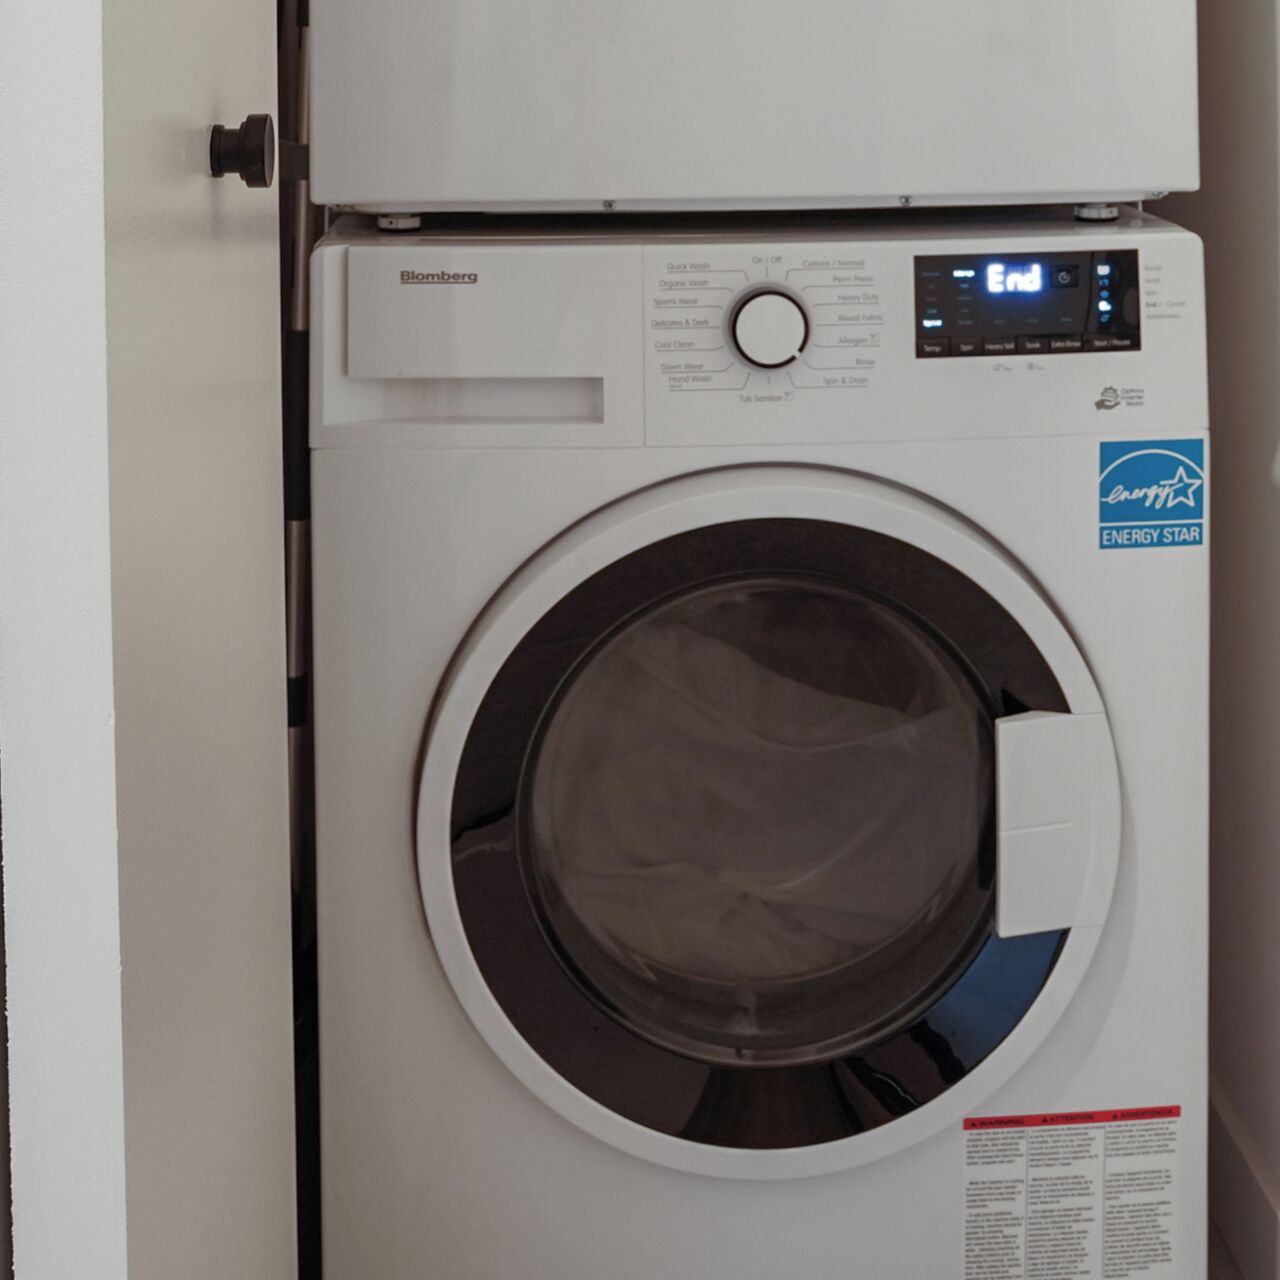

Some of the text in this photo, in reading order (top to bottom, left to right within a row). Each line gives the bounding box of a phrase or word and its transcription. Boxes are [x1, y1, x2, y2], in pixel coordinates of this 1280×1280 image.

[770, 256, 782, 264] Off
[666, 262, 711, 271] Quick Wash
[400, 270, 478, 284] Blomberg
[986, 263, 1043, 293] End
[659, 279, 710, 289] Organic Wash
[653, 297, 698, 307] Sports Wear
[837, 294, 879, 303] Heavy Duty
[837, 313, 884, 322] Mixed Fabric
[651, 319, 683, 327] Delicates
[673, 340, 695, 348] Clean
[960, 343, 974, 353] Spin
[683, 362, 704, 370] Wear
[668, 374, 712, 383] Hand Wash
[823, 376, 839, 386] Spin
[739, 394, 752, 403] Tub
[1101, 484, 1176, 510] energy
[1102, 526, 1201, 546] ENERGY STAR
[1050, 1113, 1096, 1123] ATTENTION
